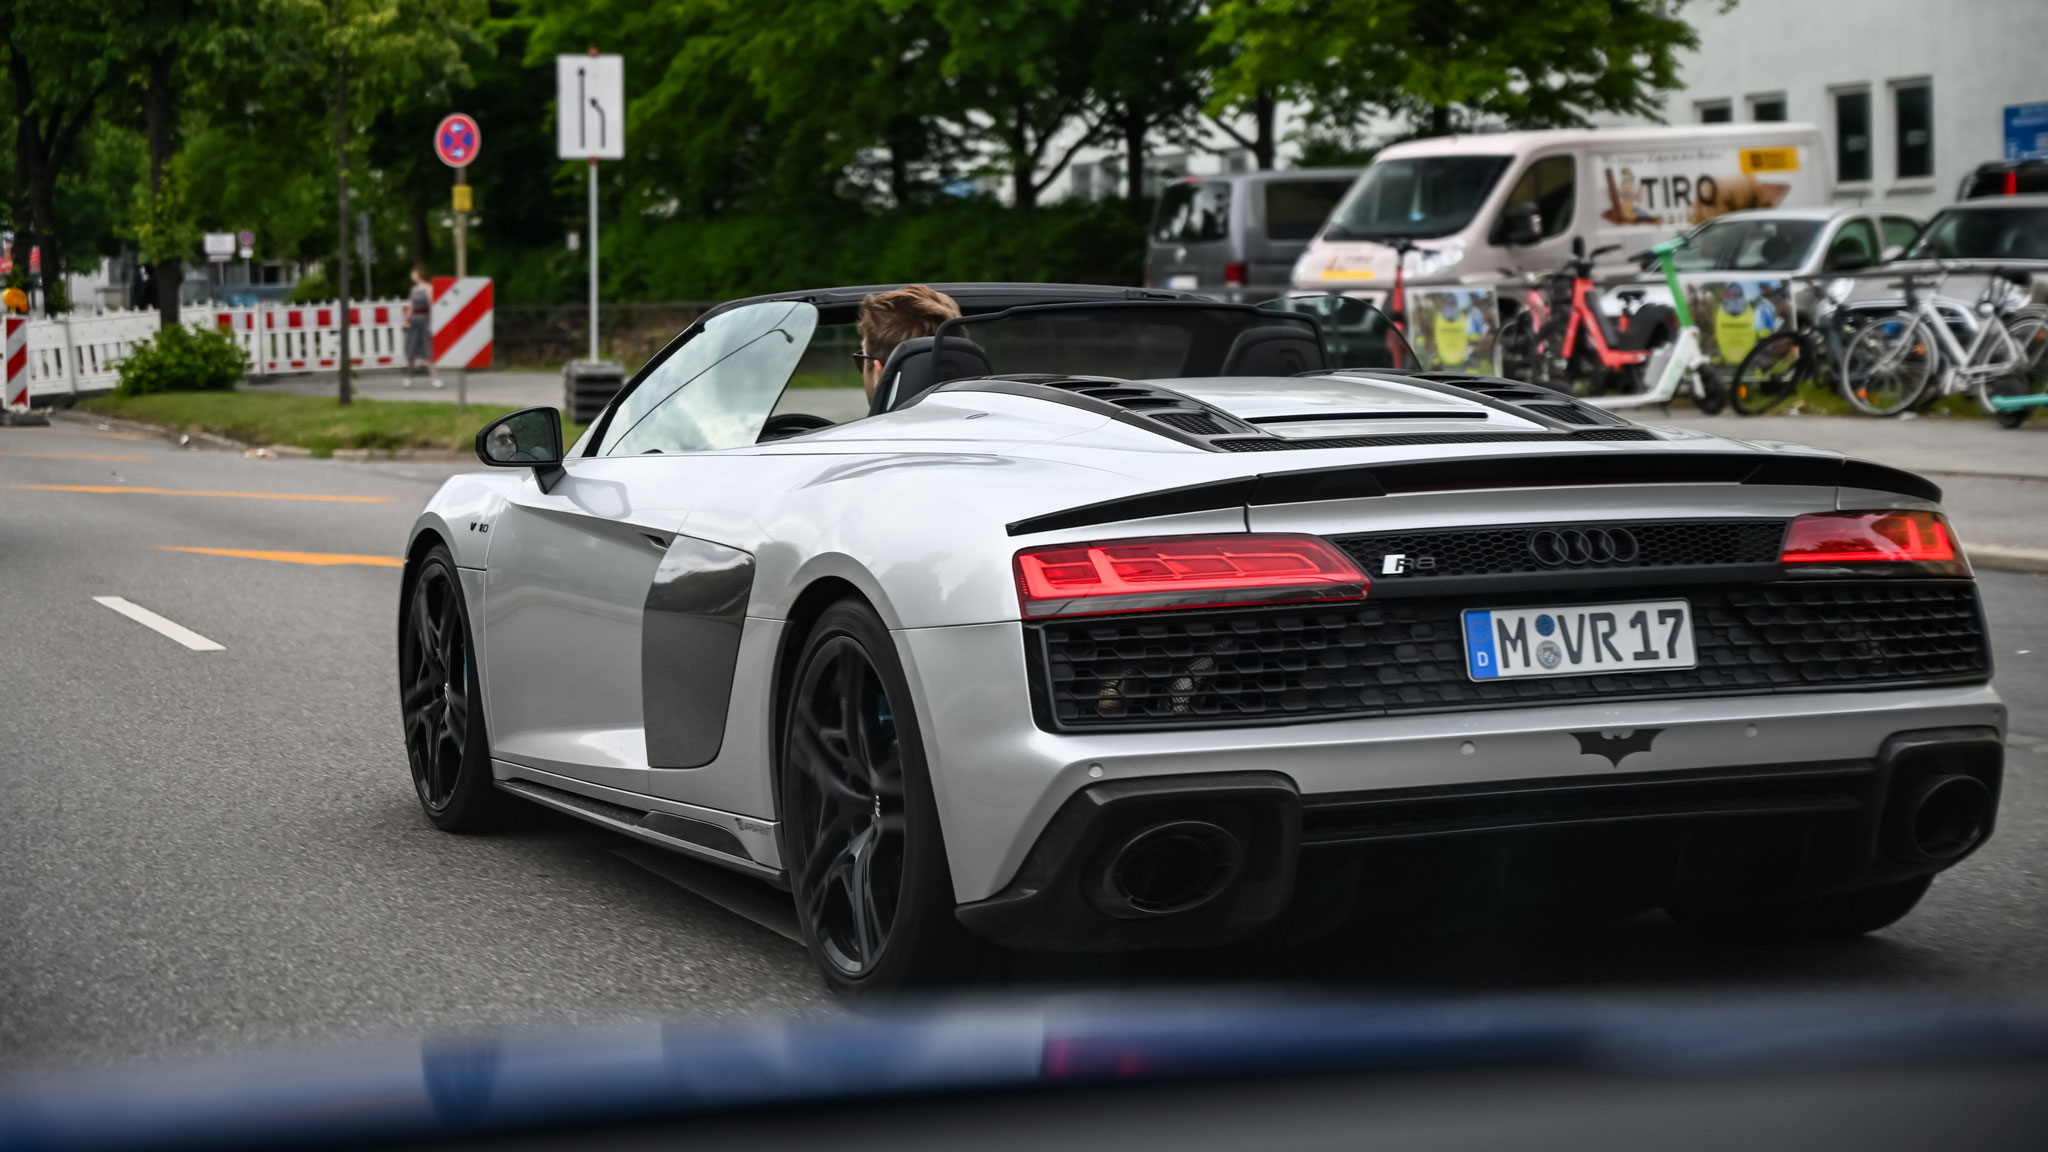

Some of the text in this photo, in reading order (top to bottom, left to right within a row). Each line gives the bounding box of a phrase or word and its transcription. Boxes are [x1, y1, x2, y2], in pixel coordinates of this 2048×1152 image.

[1640, 174, 1718, 209] TIRO
[1382, 554, 1436, 574] R8
[1476, 652, 1489, 667] D
